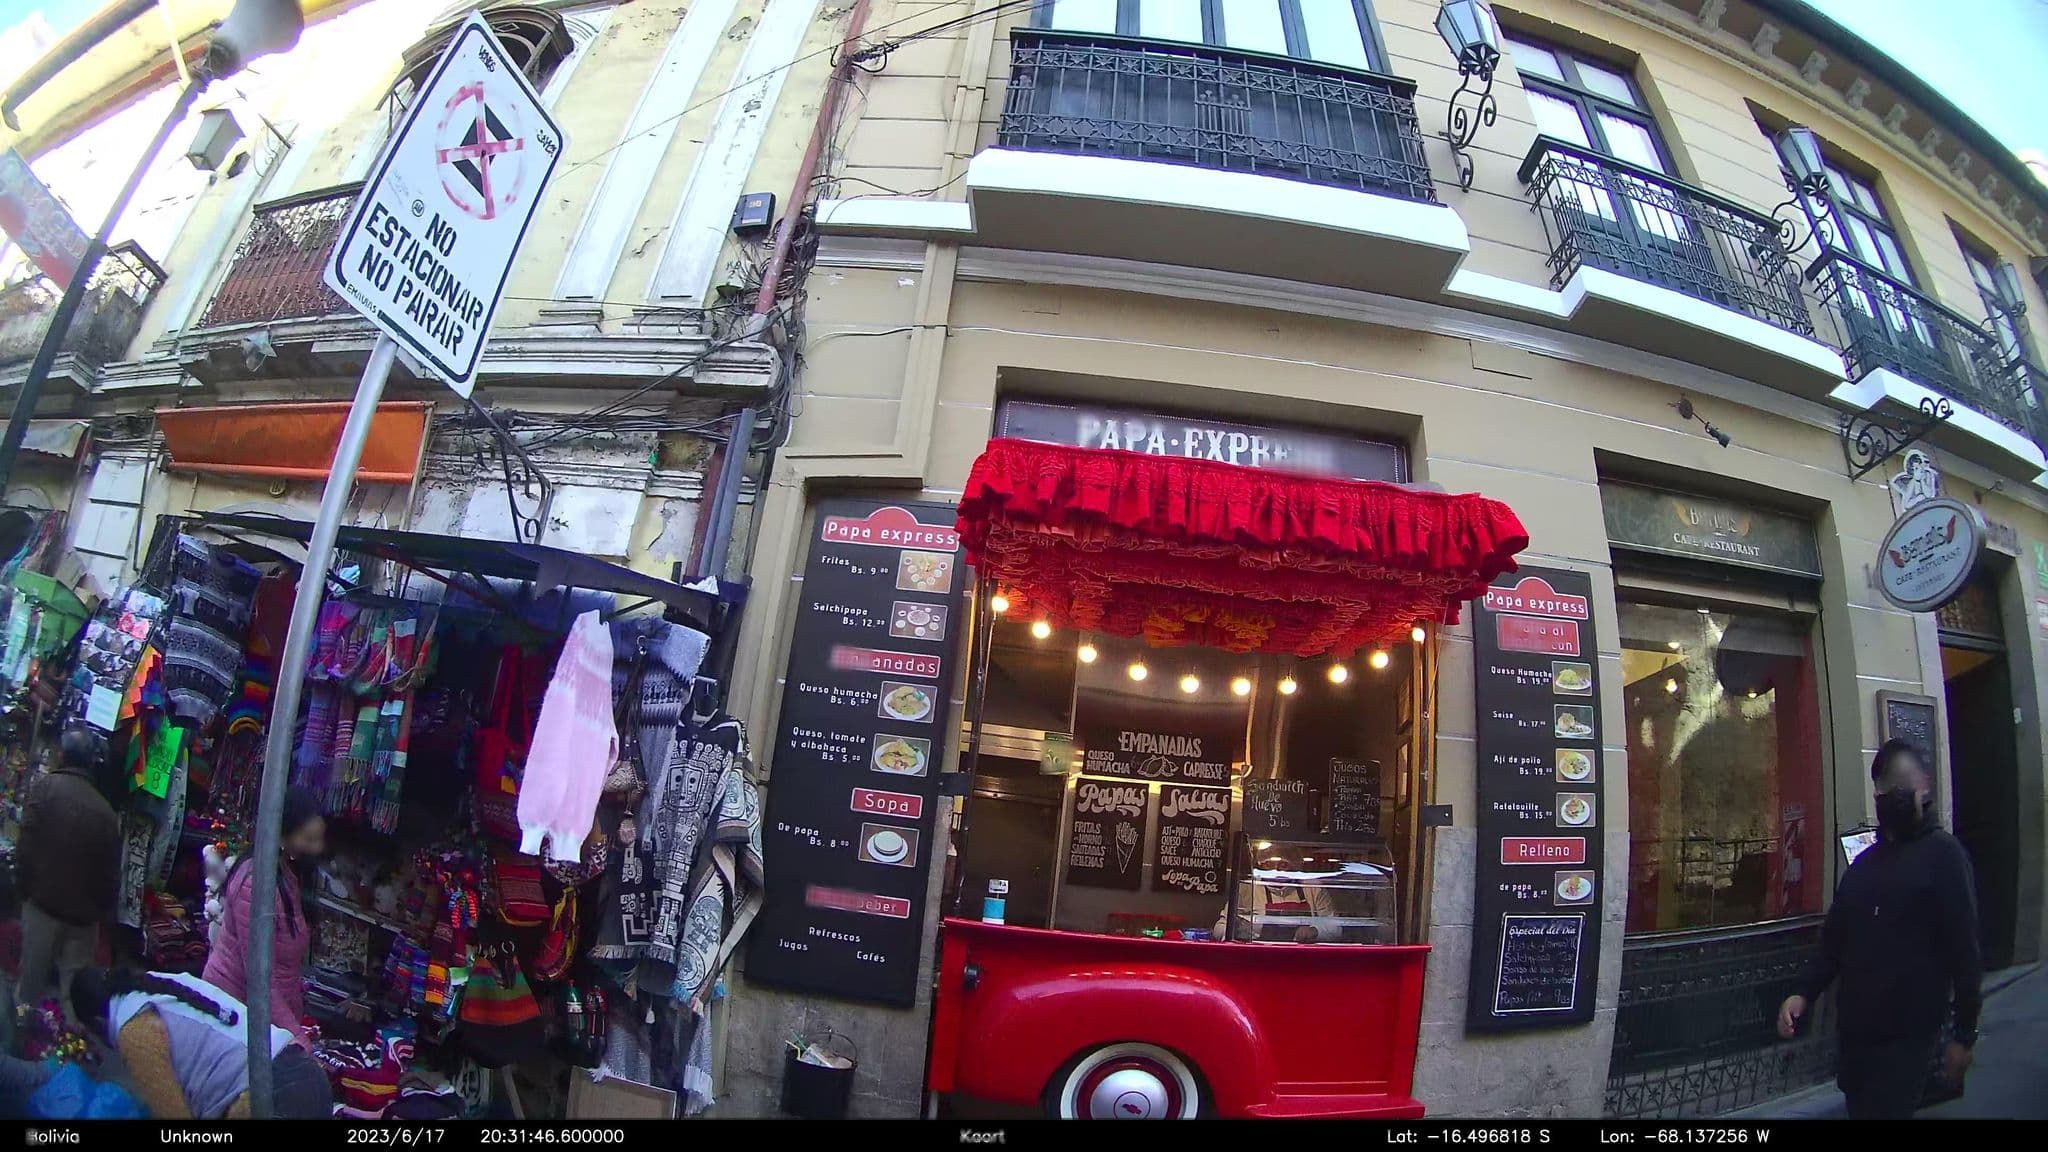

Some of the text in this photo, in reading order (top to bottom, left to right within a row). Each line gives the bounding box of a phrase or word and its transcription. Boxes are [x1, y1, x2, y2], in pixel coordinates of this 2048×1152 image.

[424, 212, 457, 257] NO
[364, 202, 484, 330] ESTACIONAR
[358, 244, 464, 356] NO PARAR
[827, 521, 955, 546] Papa express
[1486, 591, 1585, 614] Papa express
[838, 652, 936, 673] anadas
[1490, 666, 1515, 674] Queso
[800, 682, 829, 694] Queso
[1118, 731, 1202, 758] EMPANADAS
[1087, 750, 1115, 761] QUESO
[1248, 779, 1305, 794] Sandwich
[864, 794, 909, 814] Sopa
[1076, 784, 1147, 815] Papas
[1161, 788, 1230, 817] Salsas
[1493, 802, 1539, 810] Ratatouille
[1074, 821, 1102, 834] FRITAS
[1268, 814, 1278, 827] 5
[778, 822, 820, 836] De papa
[1520, 844, 1570, 857] Relleno
[1161, 856, 1181, 866] QUESO
[1162, 869, 1190, 884] Sopa
[1512, 884, 1532, 892] papa
[809, 926, 861, 942] Refrescos
[779, 938, 809, 951] Jugos
